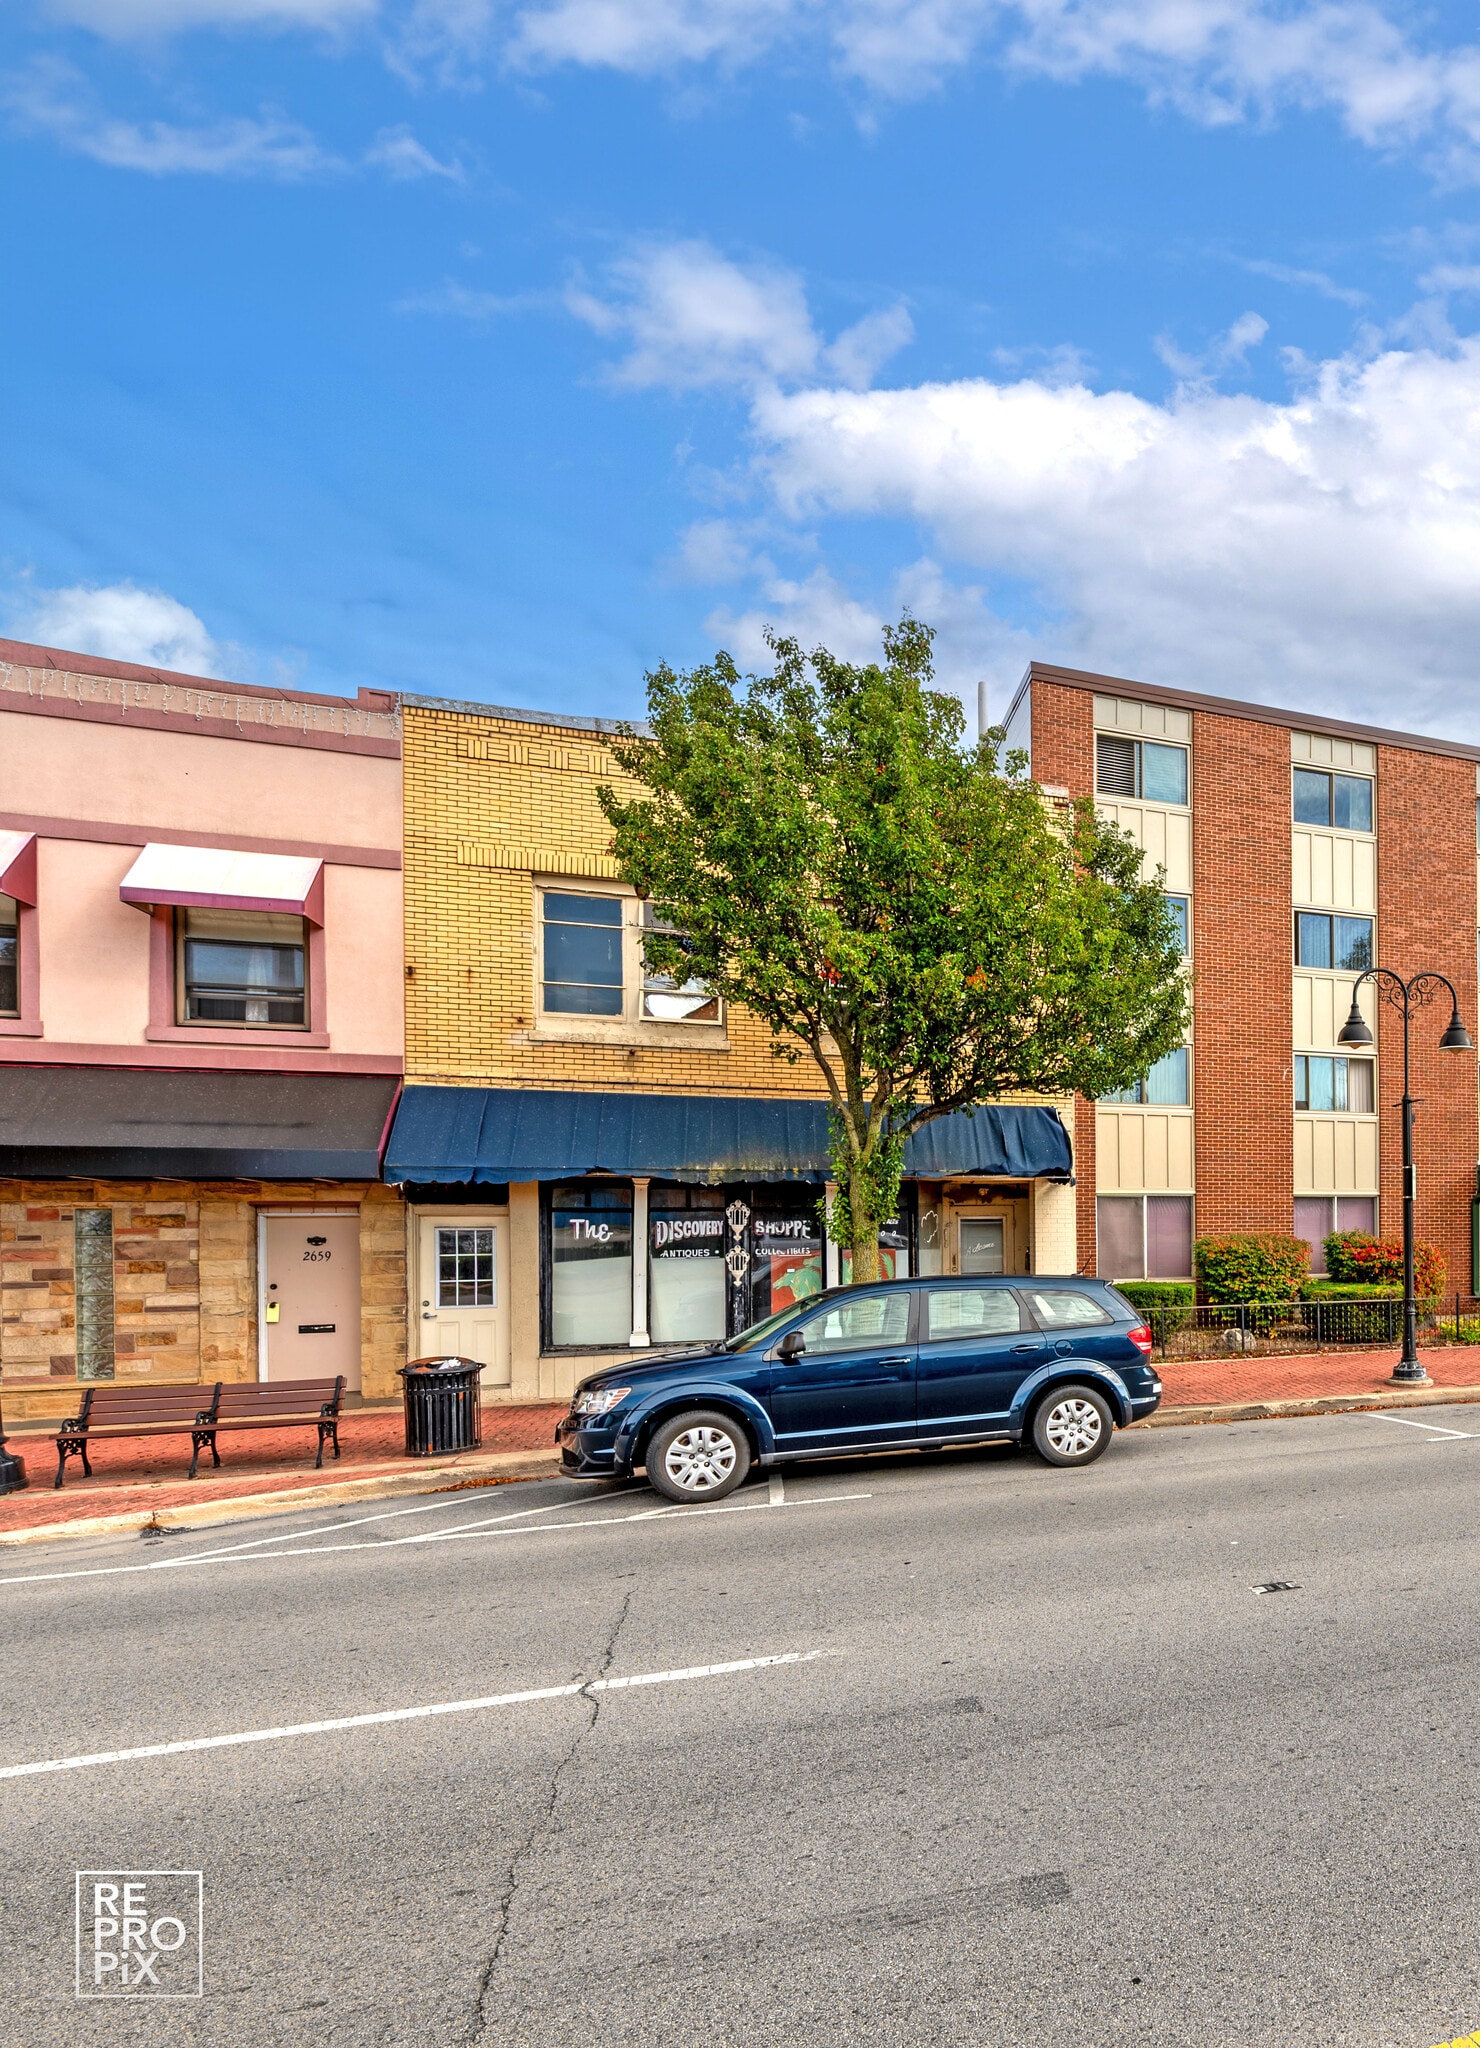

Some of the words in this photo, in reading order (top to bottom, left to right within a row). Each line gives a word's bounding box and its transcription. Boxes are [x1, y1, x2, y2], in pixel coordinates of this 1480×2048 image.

[569, 1218, 613, 1241] The
[655, 1220, 724, 1247] DISCOVERY
[755, 1220, 811, 1239] SHOPPE
[303, 1250, 332, 1262] 2659
[660, 1249, 710, 1258] ANTIQUES
